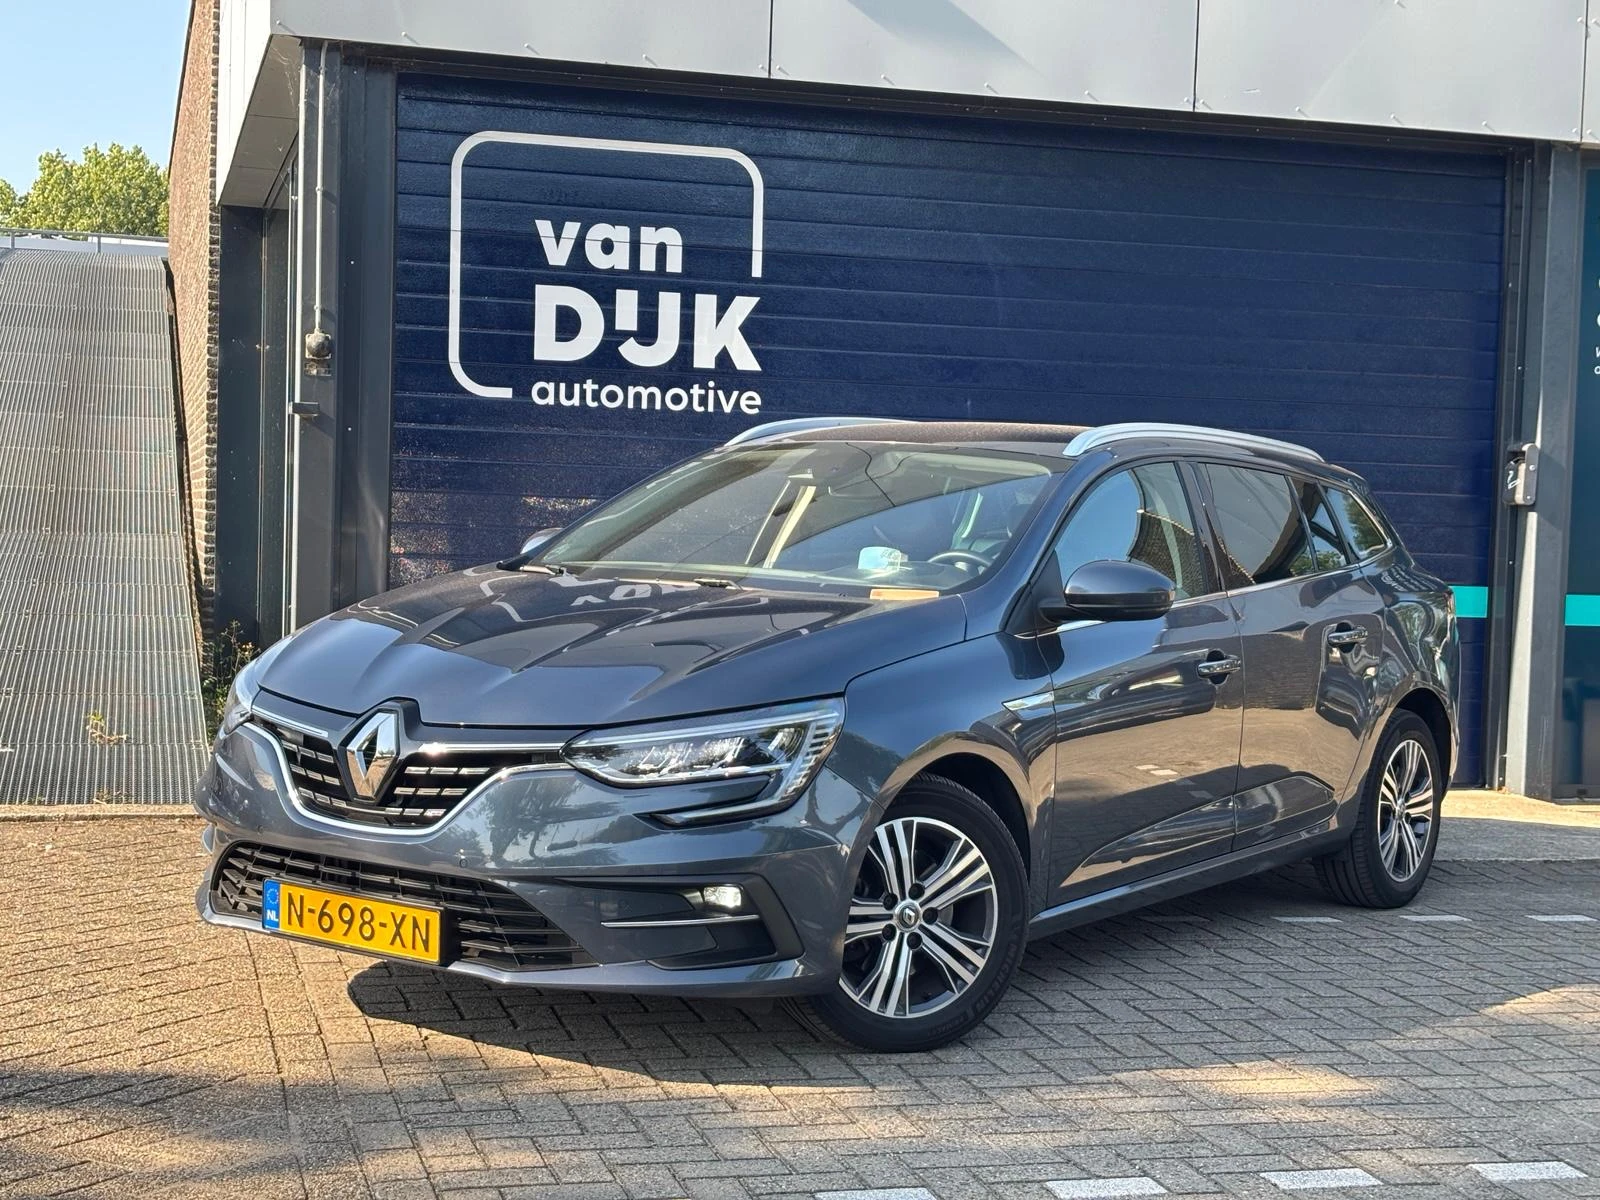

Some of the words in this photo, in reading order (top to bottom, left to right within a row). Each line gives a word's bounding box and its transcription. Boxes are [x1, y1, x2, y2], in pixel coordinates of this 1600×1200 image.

[534, 219, 683, 273] van
[533, 284, 763, 372] DIJK
[531, 379, 762, 415] automotive
[266, 909, 279, 922] NL
[287, 892, 430, 953] N-698-XN
